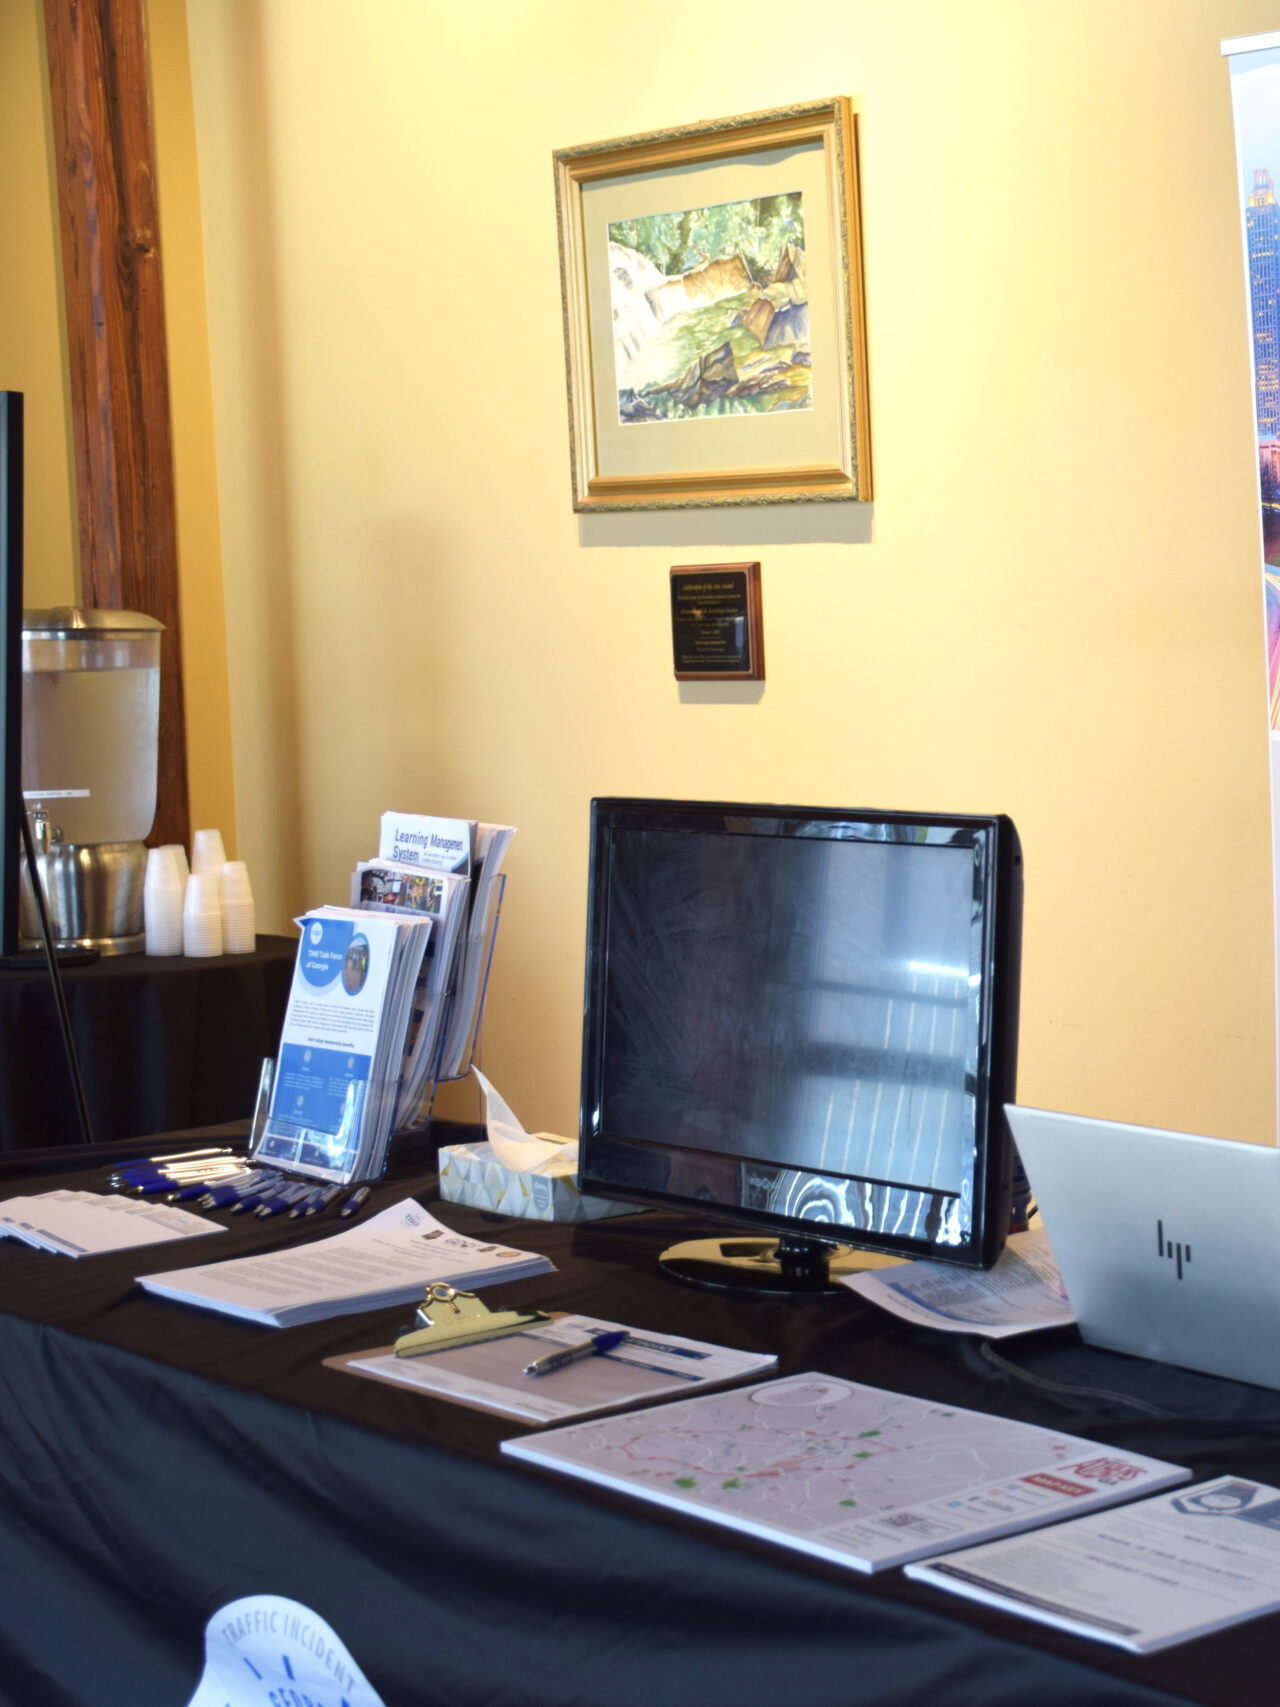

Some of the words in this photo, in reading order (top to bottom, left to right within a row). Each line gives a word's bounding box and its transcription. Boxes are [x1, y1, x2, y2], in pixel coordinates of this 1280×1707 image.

[394, 828, 429, 849] Learning
[392, 846, 419, 862] System
[222, 1609, 279, 1644] TRAFFIC
[284, 1613, 356, 1693] INCIDENT
